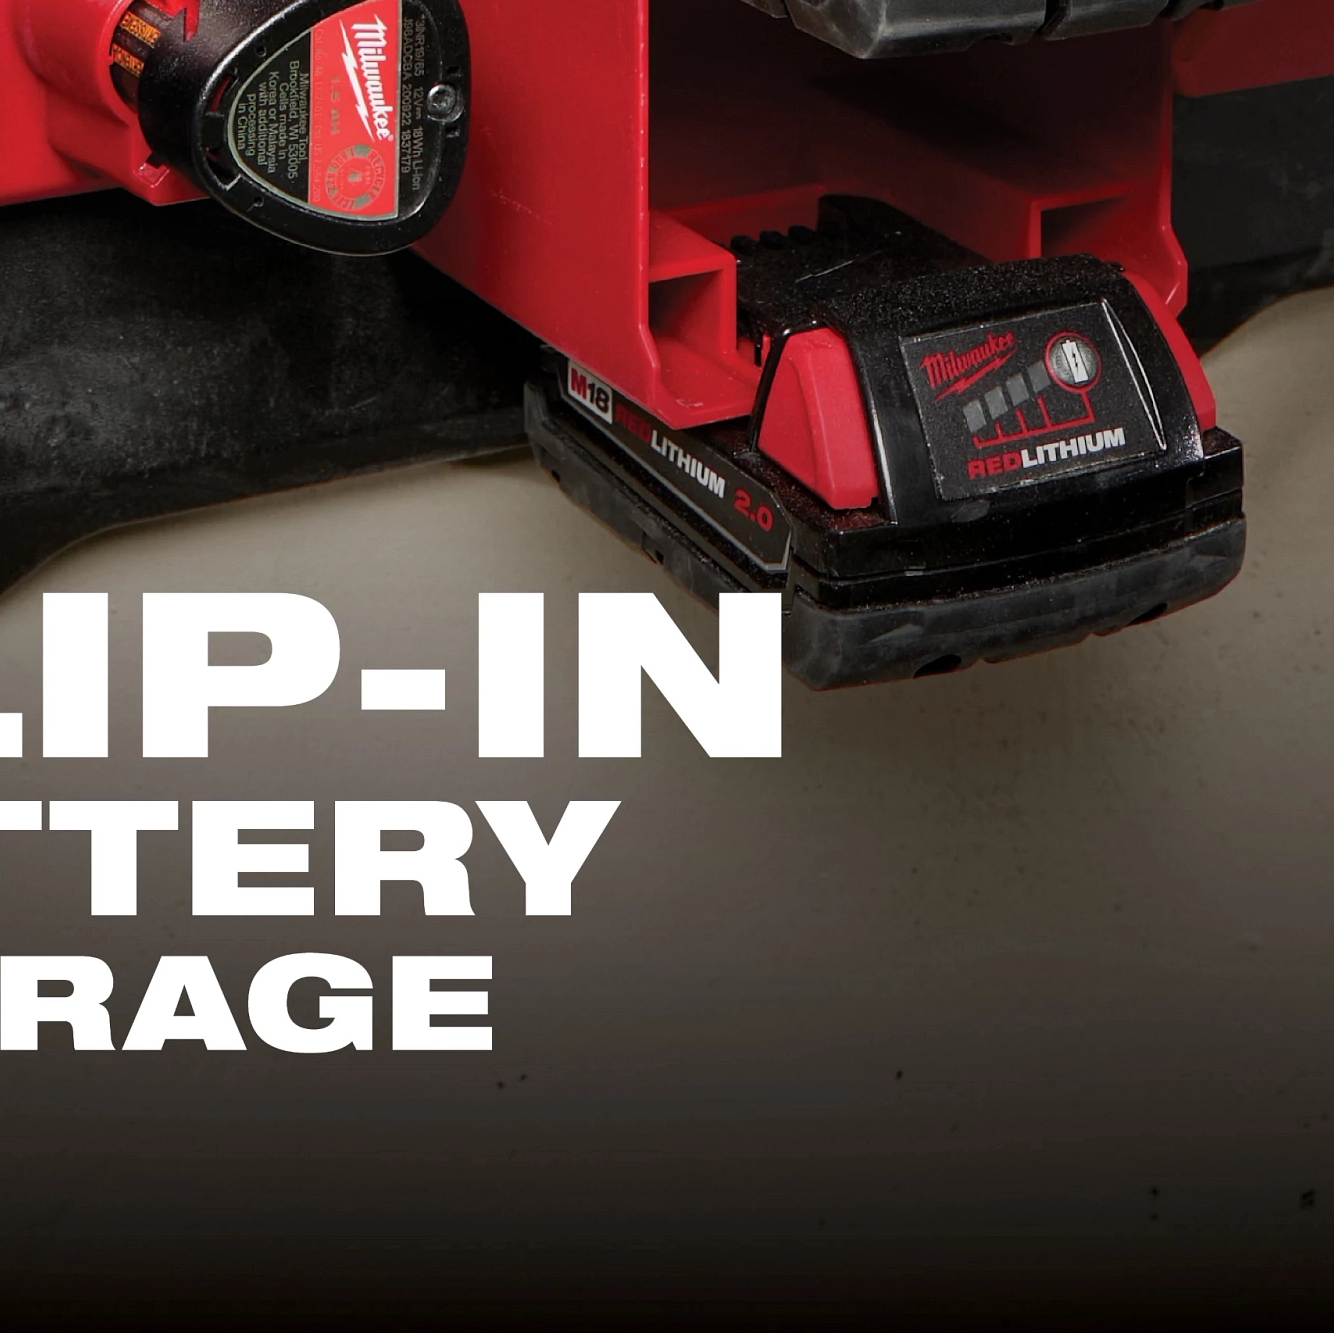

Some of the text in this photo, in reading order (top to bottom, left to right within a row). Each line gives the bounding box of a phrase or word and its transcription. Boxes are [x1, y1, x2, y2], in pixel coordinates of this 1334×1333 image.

[351, 14, 393, 141] Milwaukee
[919, 332, 1014, 389] Milwaukee
[571, 367, 773, 531] M18 REDLITHIUM 2.0
[967, 428, 1126, 479] REDLITHIUM
